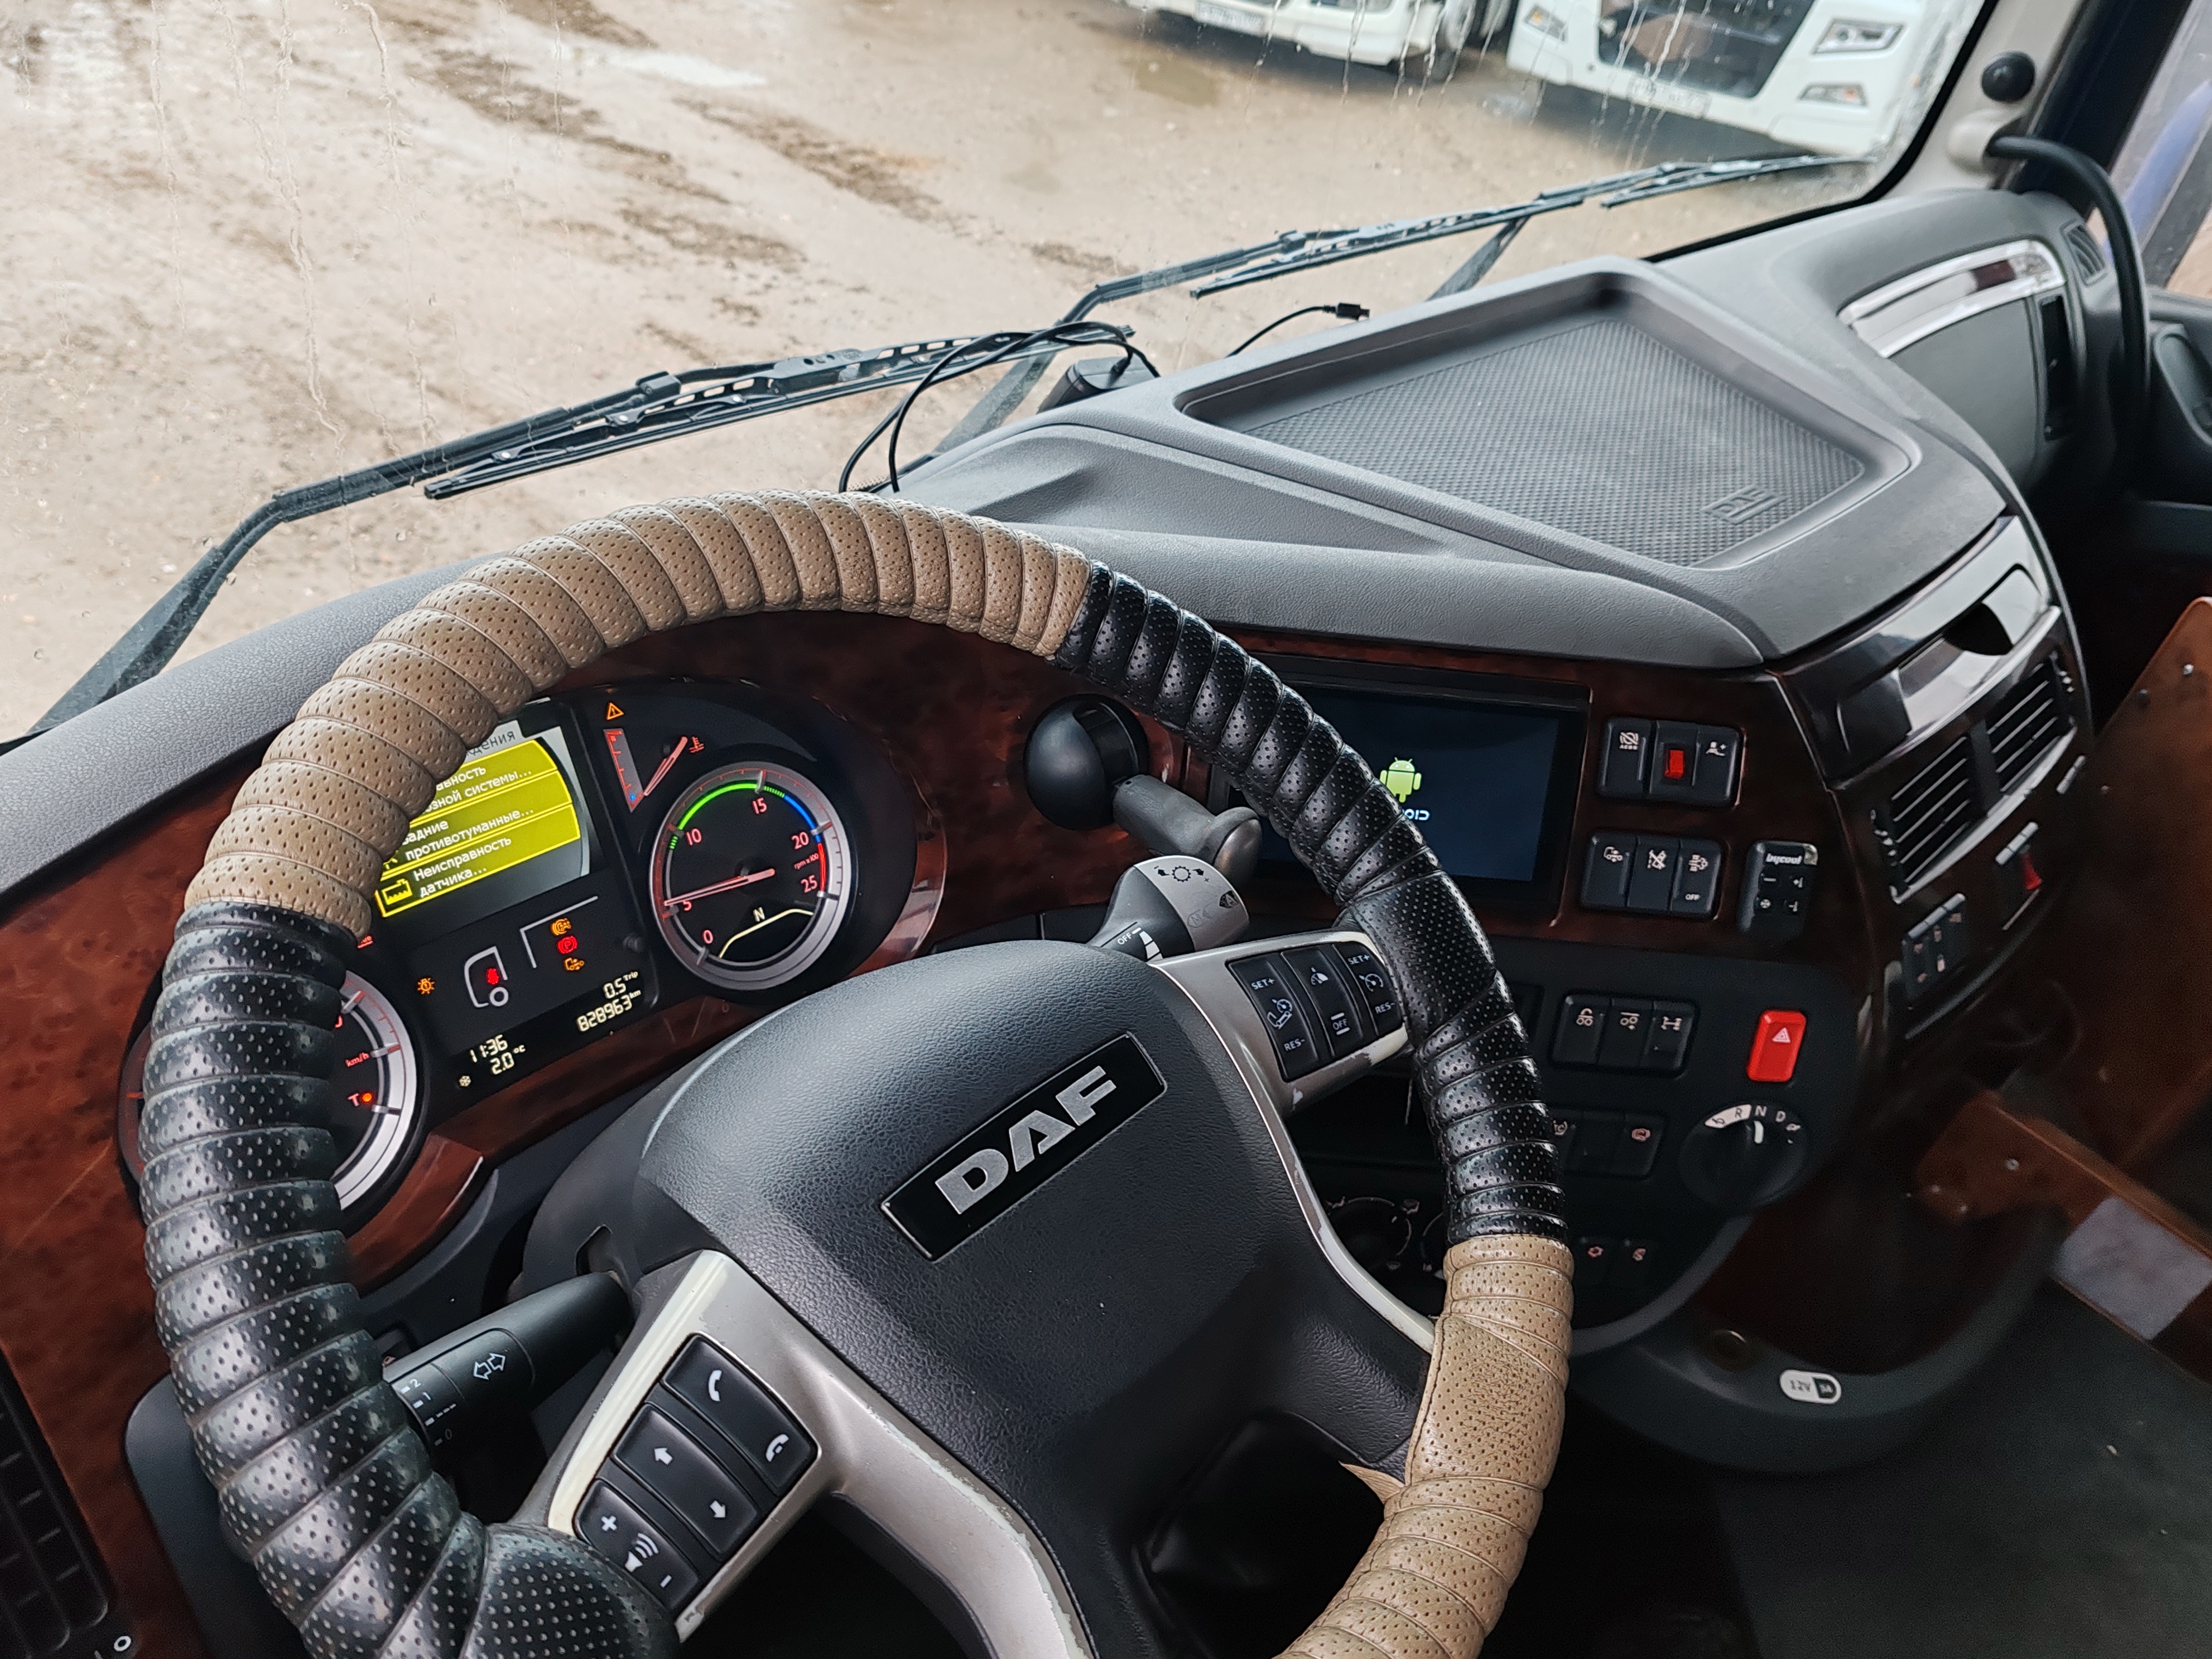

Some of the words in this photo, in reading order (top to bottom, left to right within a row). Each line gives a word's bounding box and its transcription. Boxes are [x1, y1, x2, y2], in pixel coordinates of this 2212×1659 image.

[436, 766, 486, 791] авность
[425, 789, 462, 813] озной
[465, 770, 532, 797] системы...
[752, 797, 767, 814] 15
[405, 809, 533, 861] противотуманные...
[686, 828, 702, 846] 10
[791, 831, 809, 850] 20
[413, 837, 512, 881] Неисправность
[420, 868, 487, 898] датчика...
[801, 875, 818, 893] 25
[753, 907, 765, 922] N
[702, 929, 714, 944] 0
[1117, 932, 1132, 945] OFF
[1347, 954, 1370, 965] SET+
[603, 978, 626, 999] 0.5
[623, 970, 638, 981] Trip
[1251, 978, 1274, 990] SET+
[576, 994, 632, 1031] 828963
[630, 990, 641, 1000] km
[1332, 1019, 1348, 1030] OFF
[469, 1034, 508, 1063] 11:36
[1283, 1038, 1306, 1051] RES-
[346, 1052, 370, 1067] km/h
[489, 1052, 515, 1076] 2.0
[1755, 1105, 1767, 1116] N
[1775, 1110, 1786, 1122] D
[935, 1065, 1117, 1215] DAF
[410, 1379, 421, 1388] 2
[422, 1392, 432, 1401] 1
